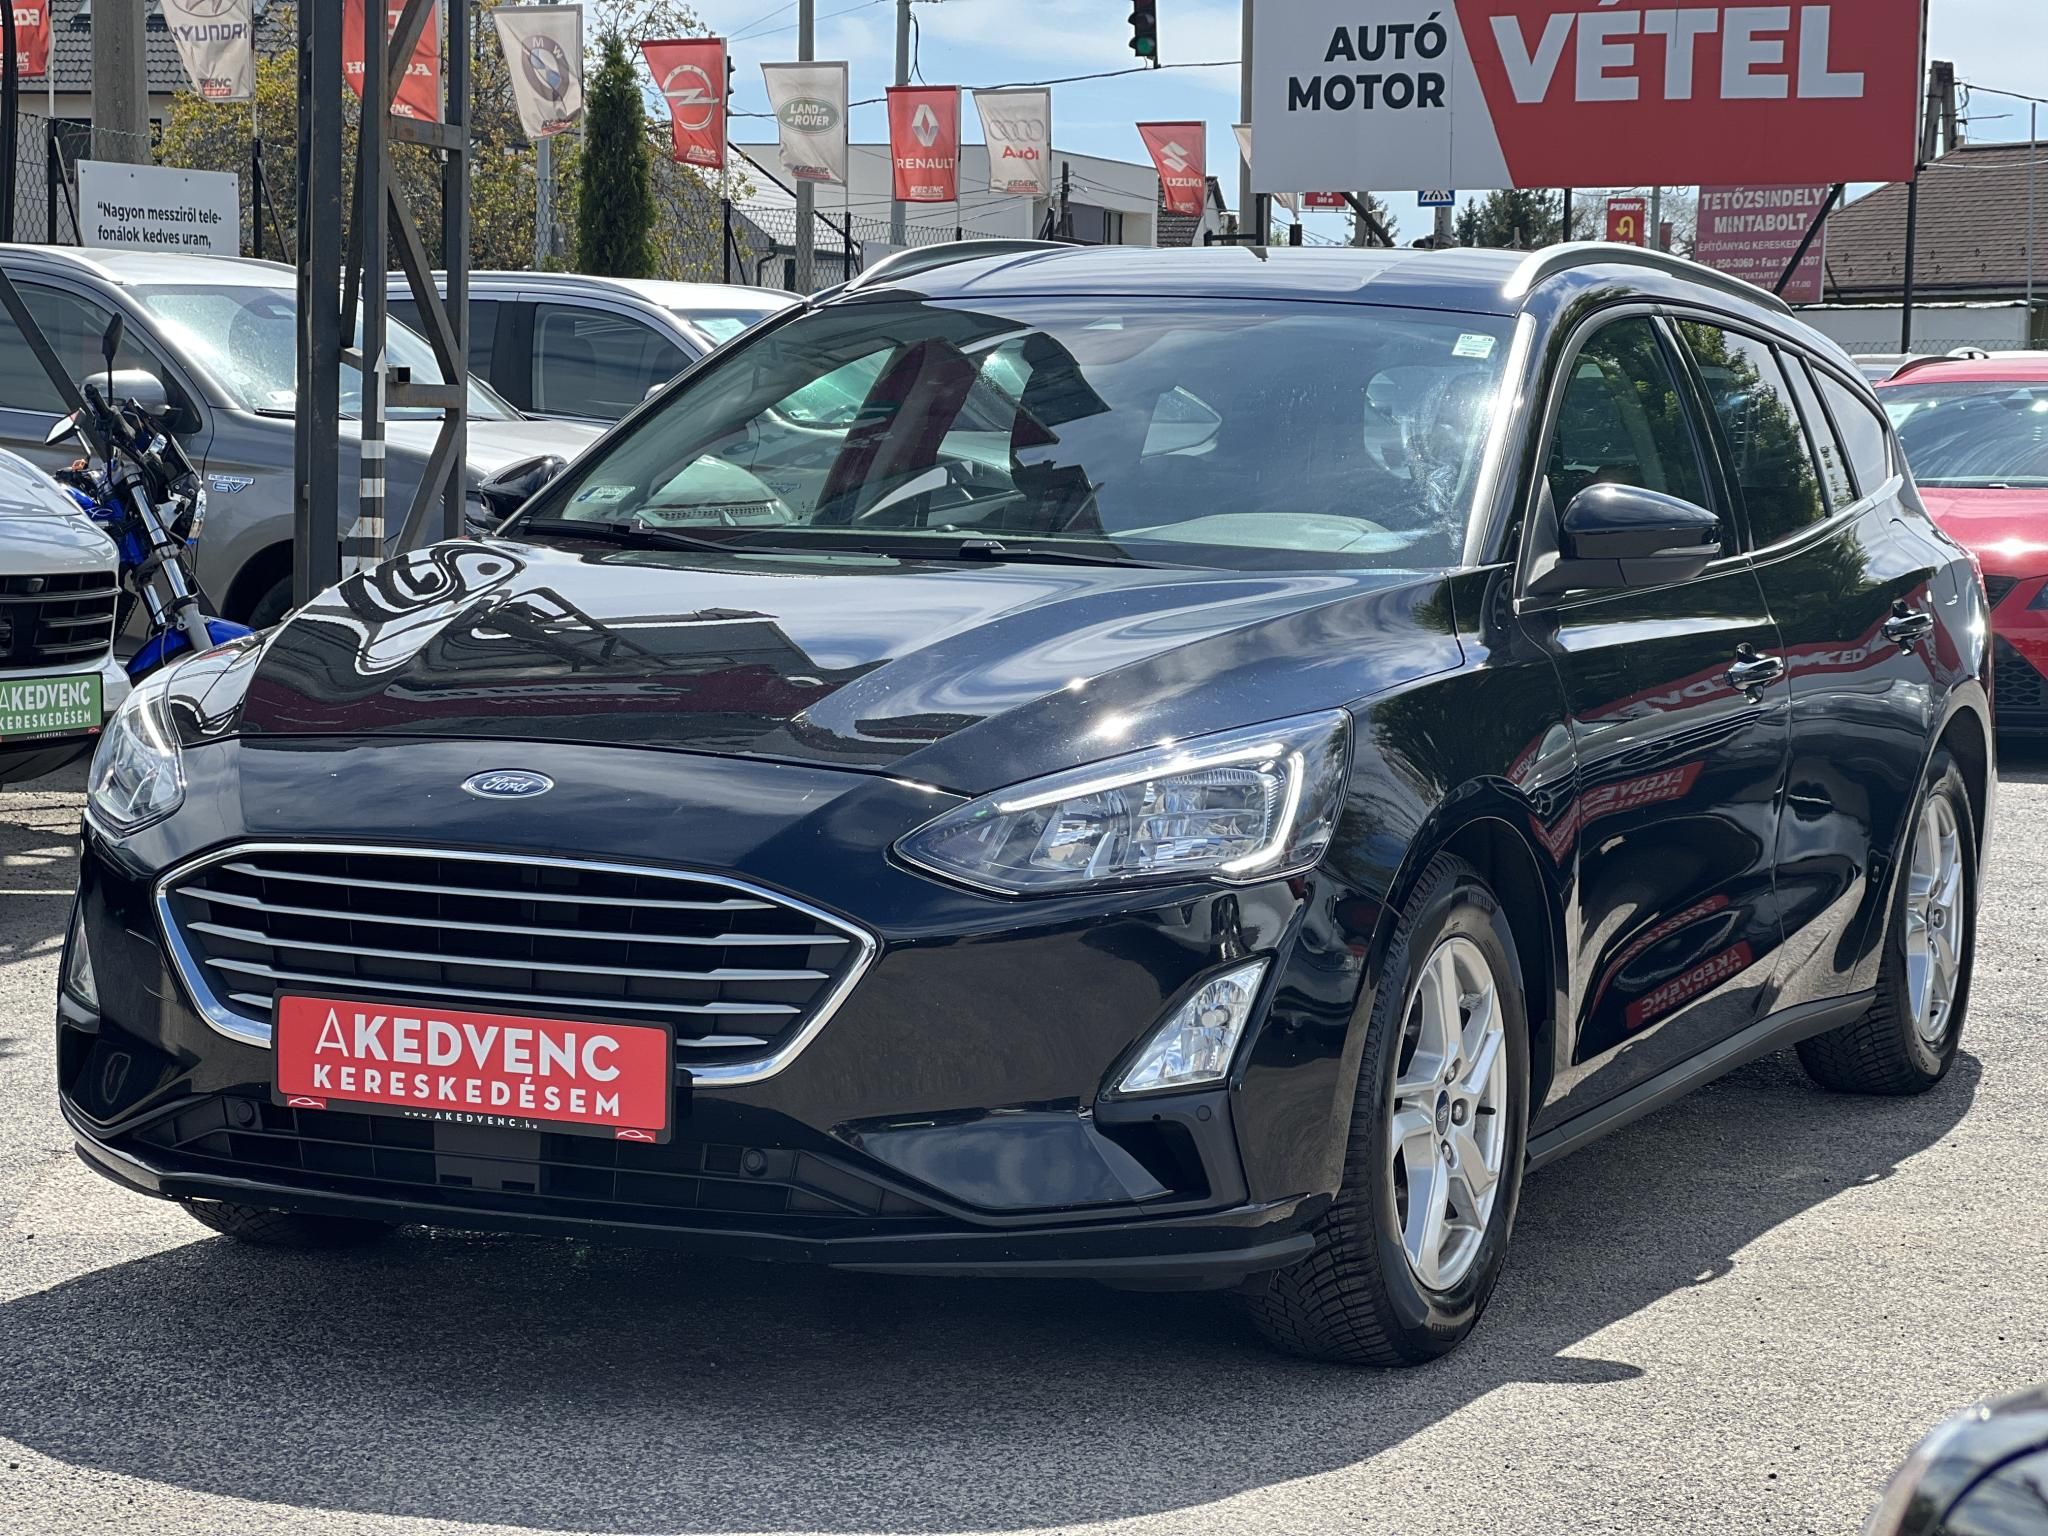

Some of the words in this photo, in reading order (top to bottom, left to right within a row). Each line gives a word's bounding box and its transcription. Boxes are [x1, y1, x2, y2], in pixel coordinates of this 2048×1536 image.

[1323, 11, 1447, 62] AUTÓ
[1489, 0, 1864, 104] VÉTEL
[1288, 73, 1445, 111] MOTOR
[790, 103, 819, 115] LAND
[794, 115, 829, 126] ROVER
[1003, 145, 1039, 160] Audi
[896, 158, 955, 169] RENAULT
[1166, 177, 1202, 187] UZUKI
[1702, 185, 1824, 210] TETŐZSINDELY
[147, 206, 196, 223] messziről
[199, 208, 222, 224] tele-
[98, 224, 140, 242] fonálok
[142, 228, 180, 244] kedves
[182, 234, 211, 248] uram,
[213, 481, 248, 494] EV
[0, 681, 91, 712] AKEDVENC
[482, 776, 534, 792] Ford
[314, 1007, 621, 1082] AKEDVENC
[313, 1063, 620, 1117] KERESKEDÉSEM
[404, 1111, 538, 1129] www.AKEDVENC.hu
